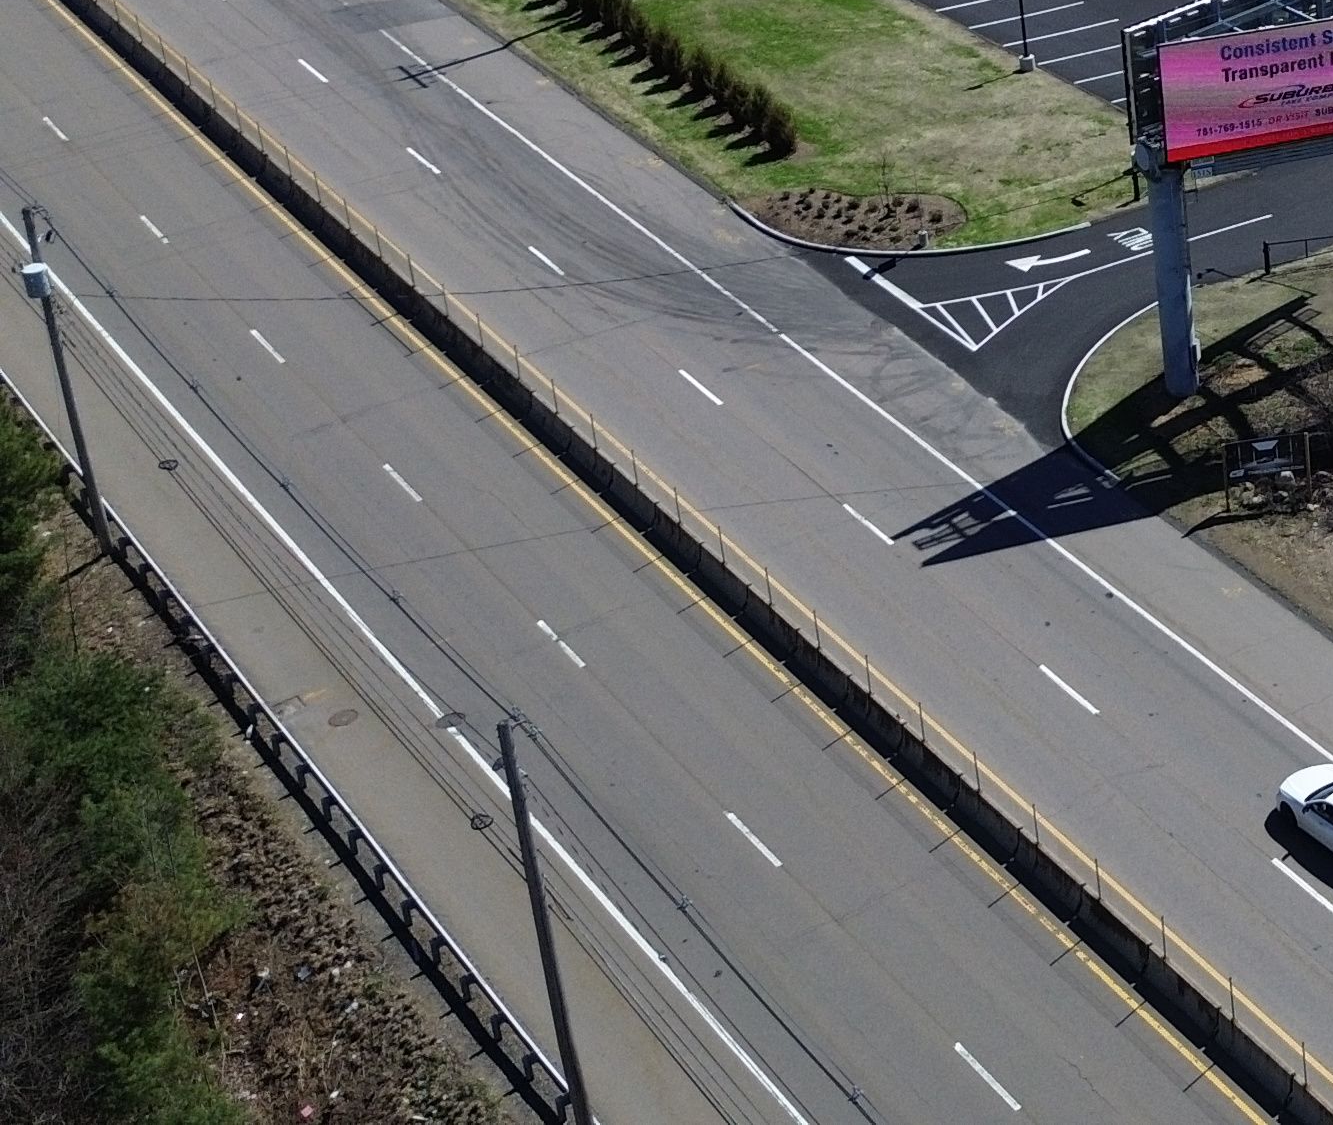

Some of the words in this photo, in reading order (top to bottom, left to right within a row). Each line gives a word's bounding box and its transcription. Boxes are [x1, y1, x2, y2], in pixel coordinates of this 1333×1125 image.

[1220, 33, 1317, 61] Consistent
[1221, 53, 1325, 83] Transparent
[1196, 118, 1262, 137] 781-769-1515
